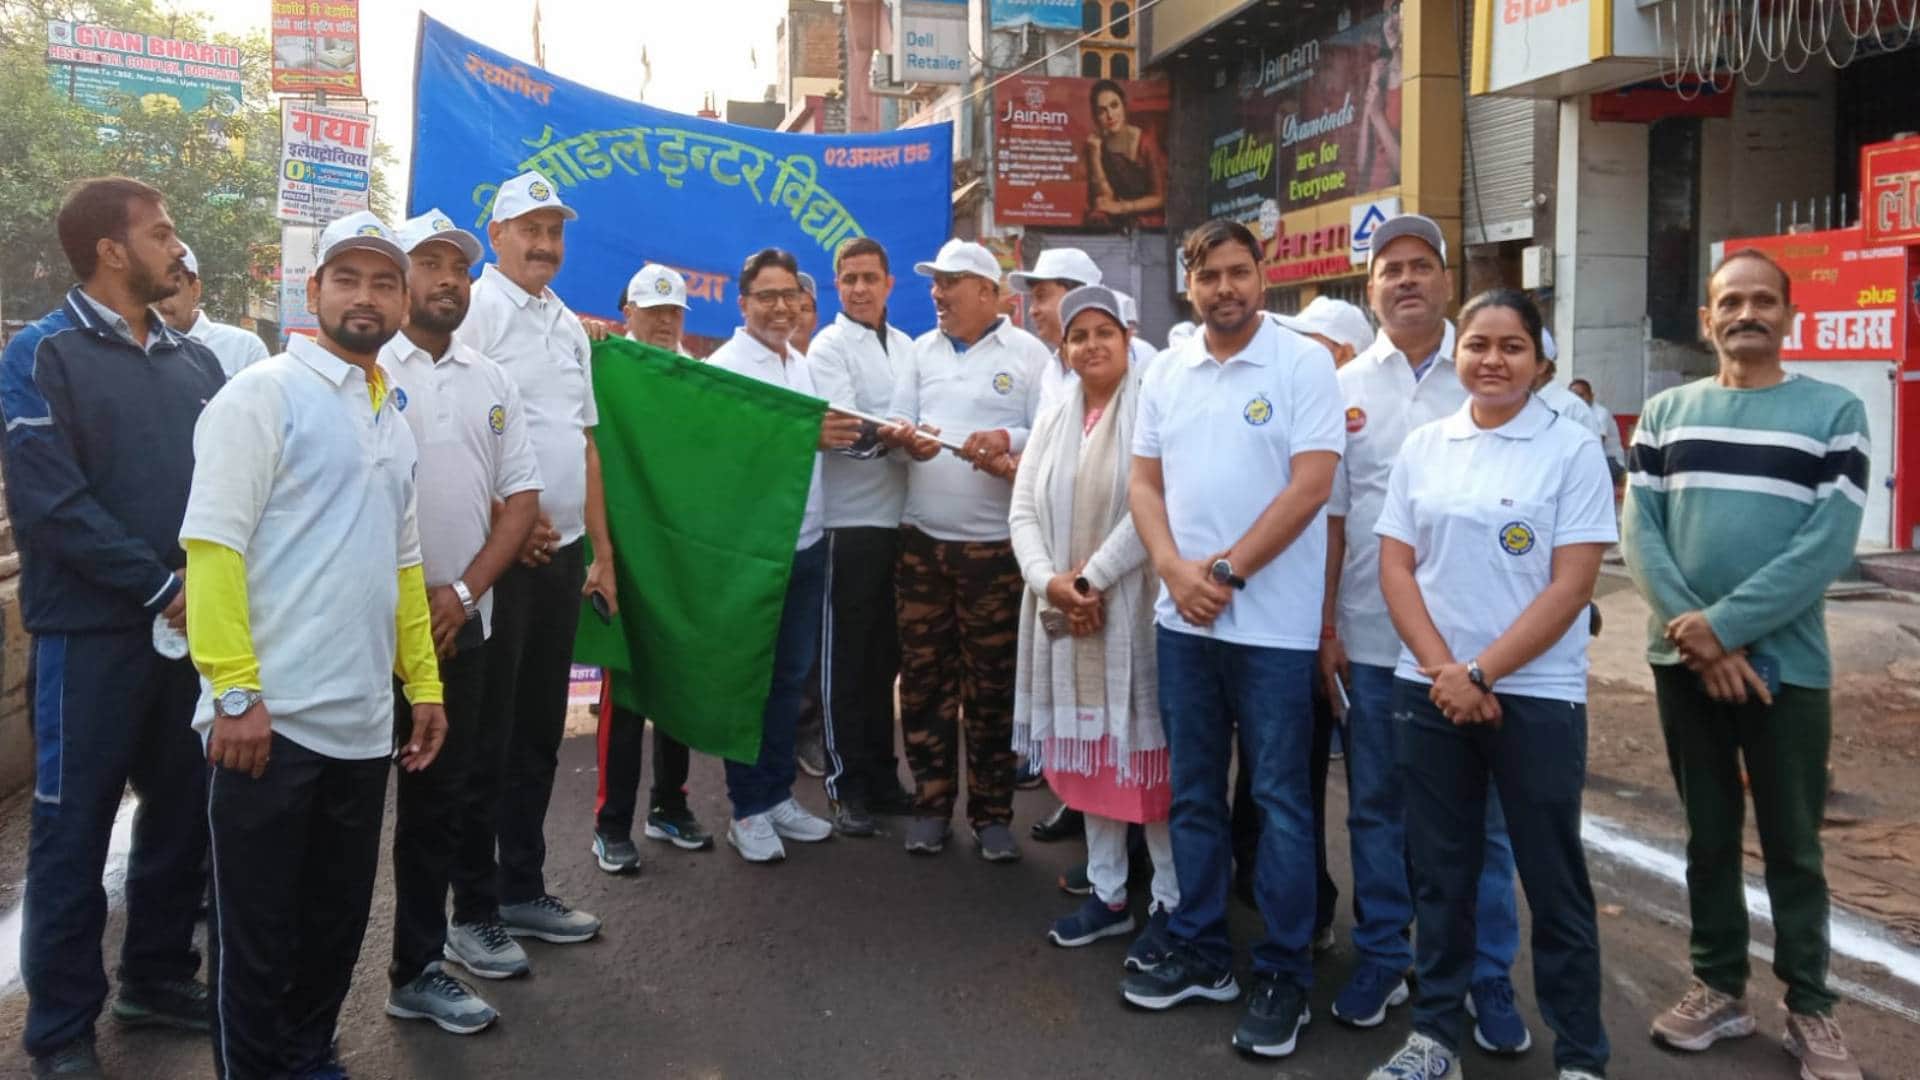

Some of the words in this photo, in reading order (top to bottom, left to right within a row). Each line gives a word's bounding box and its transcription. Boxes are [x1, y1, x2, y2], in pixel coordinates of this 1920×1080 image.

[75, 25, 143, 54] GYAN
[147, 35, 240, 67] BHARTI
[907, 32, 933, 47] Dell
[907, 54, 963, 71] Retailer
[288, 109, 370, 148] गया
[1281, 92, 1356, 147] Diamonds
[655, 126, 773, 204] इन्टर
[1210, 132, 1274, 183] Wedding
[1296, 151, 1316, 172] are
[1320, 142, 1340, 163] for
[1289, 170, 1346, 201] Everyone
[1856, 285, 1897, 308] plus
[1814, 309, 1896, 350] हाउस
